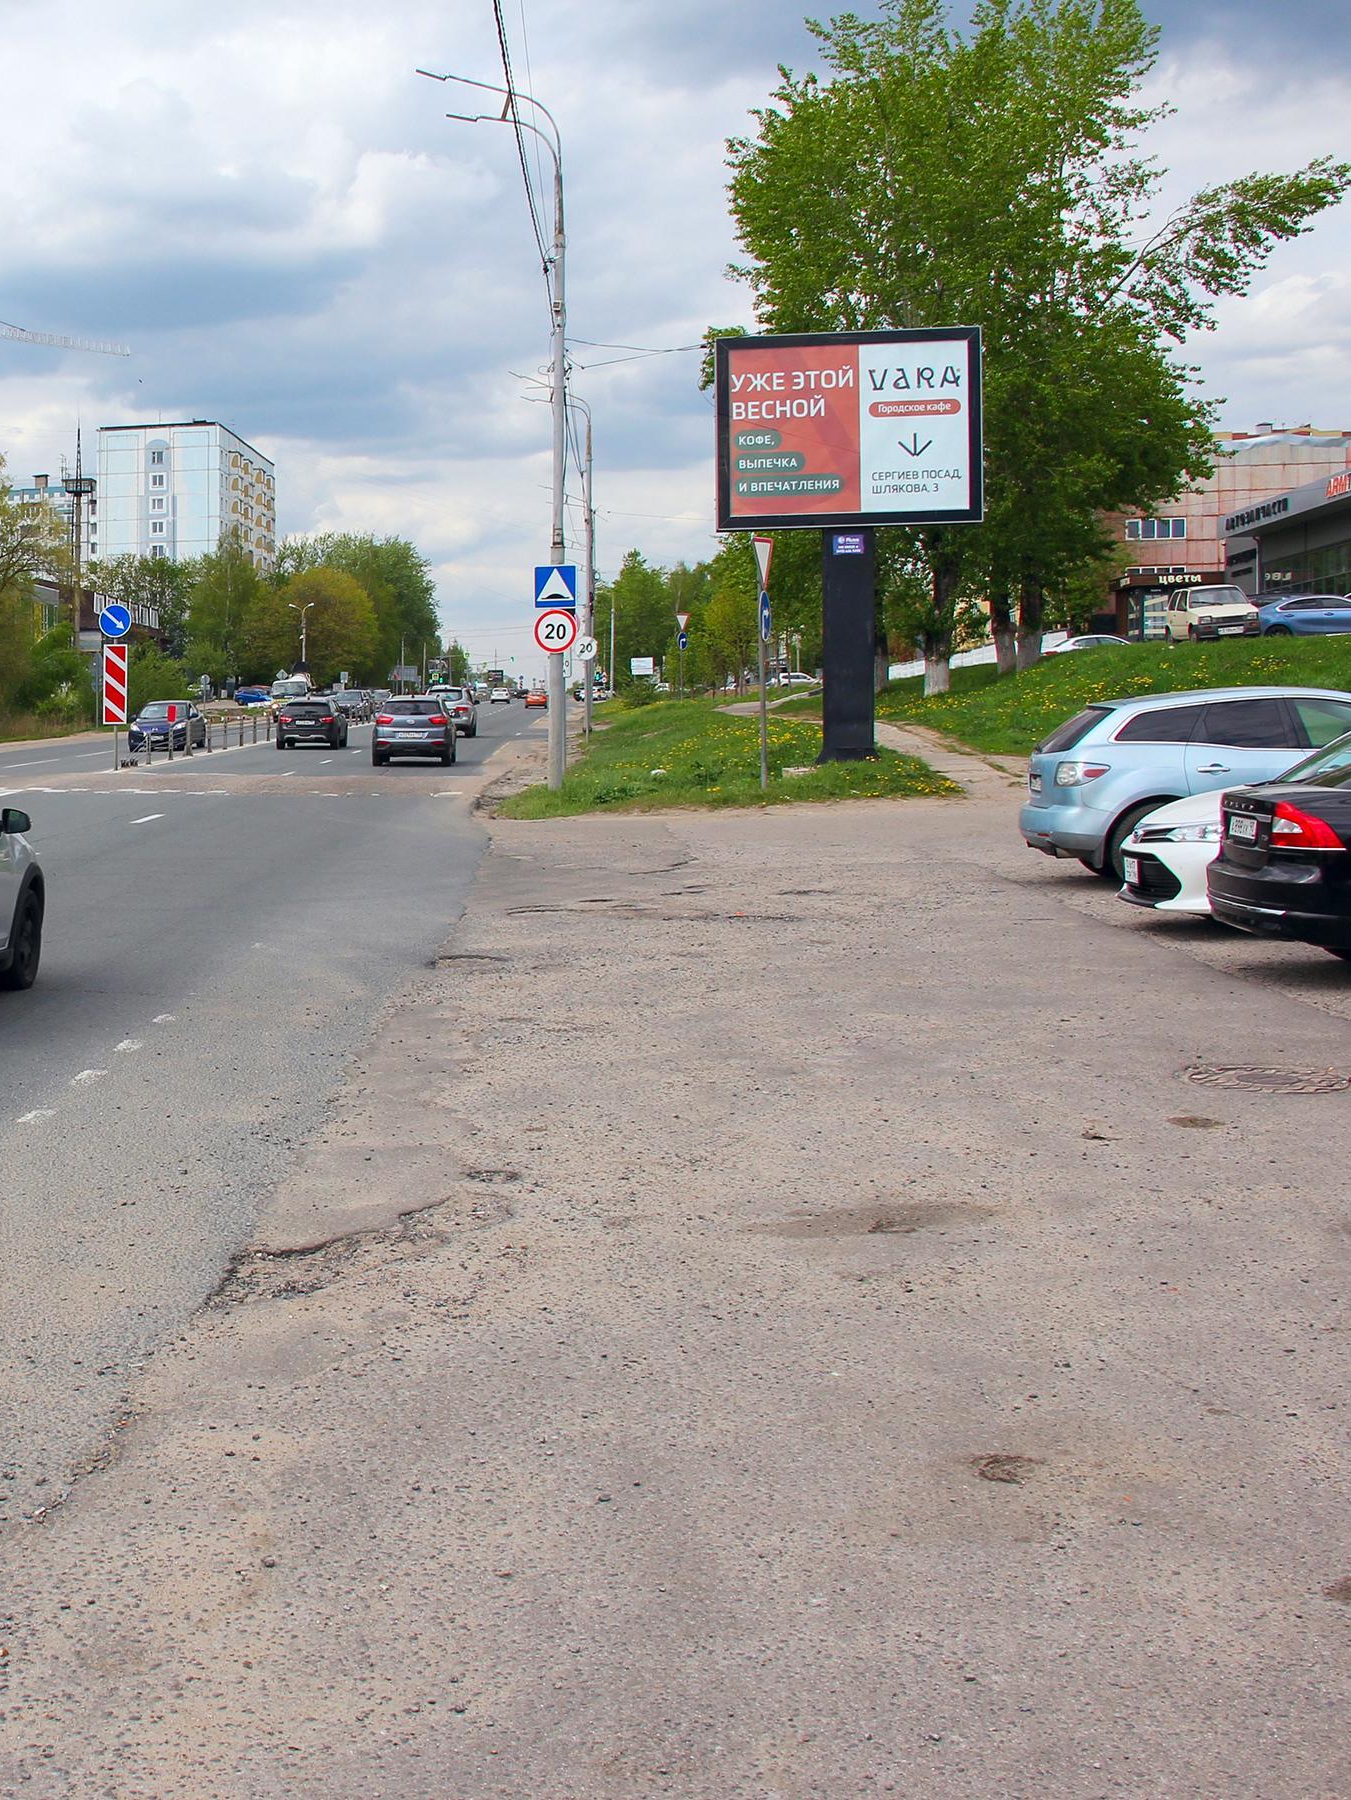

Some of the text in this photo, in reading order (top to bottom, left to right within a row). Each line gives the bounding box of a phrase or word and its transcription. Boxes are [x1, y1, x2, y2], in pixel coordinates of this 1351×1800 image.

[731, 365, 854, 392] УЖЕ ЭТОЙ
[732, 394, 825, 420] ВЕСНОЙ
[878, 401, 951, 414] Городское кафе
[738, 434, 775, 446] КОФЕ,
[738, 457, 798, 469] ВЫПЕЧКА
[871, 469, 962, 481] СЕРГИЕВ ПОСАД,
[738, 479, 840, 492] И ВПЕЧАТЛЕНИЯ
[872, 483, 939, 495] ШЛЯКОВА, 3
[544, 623, 566, 640] 20
[579, 642, 593, 654] 20
